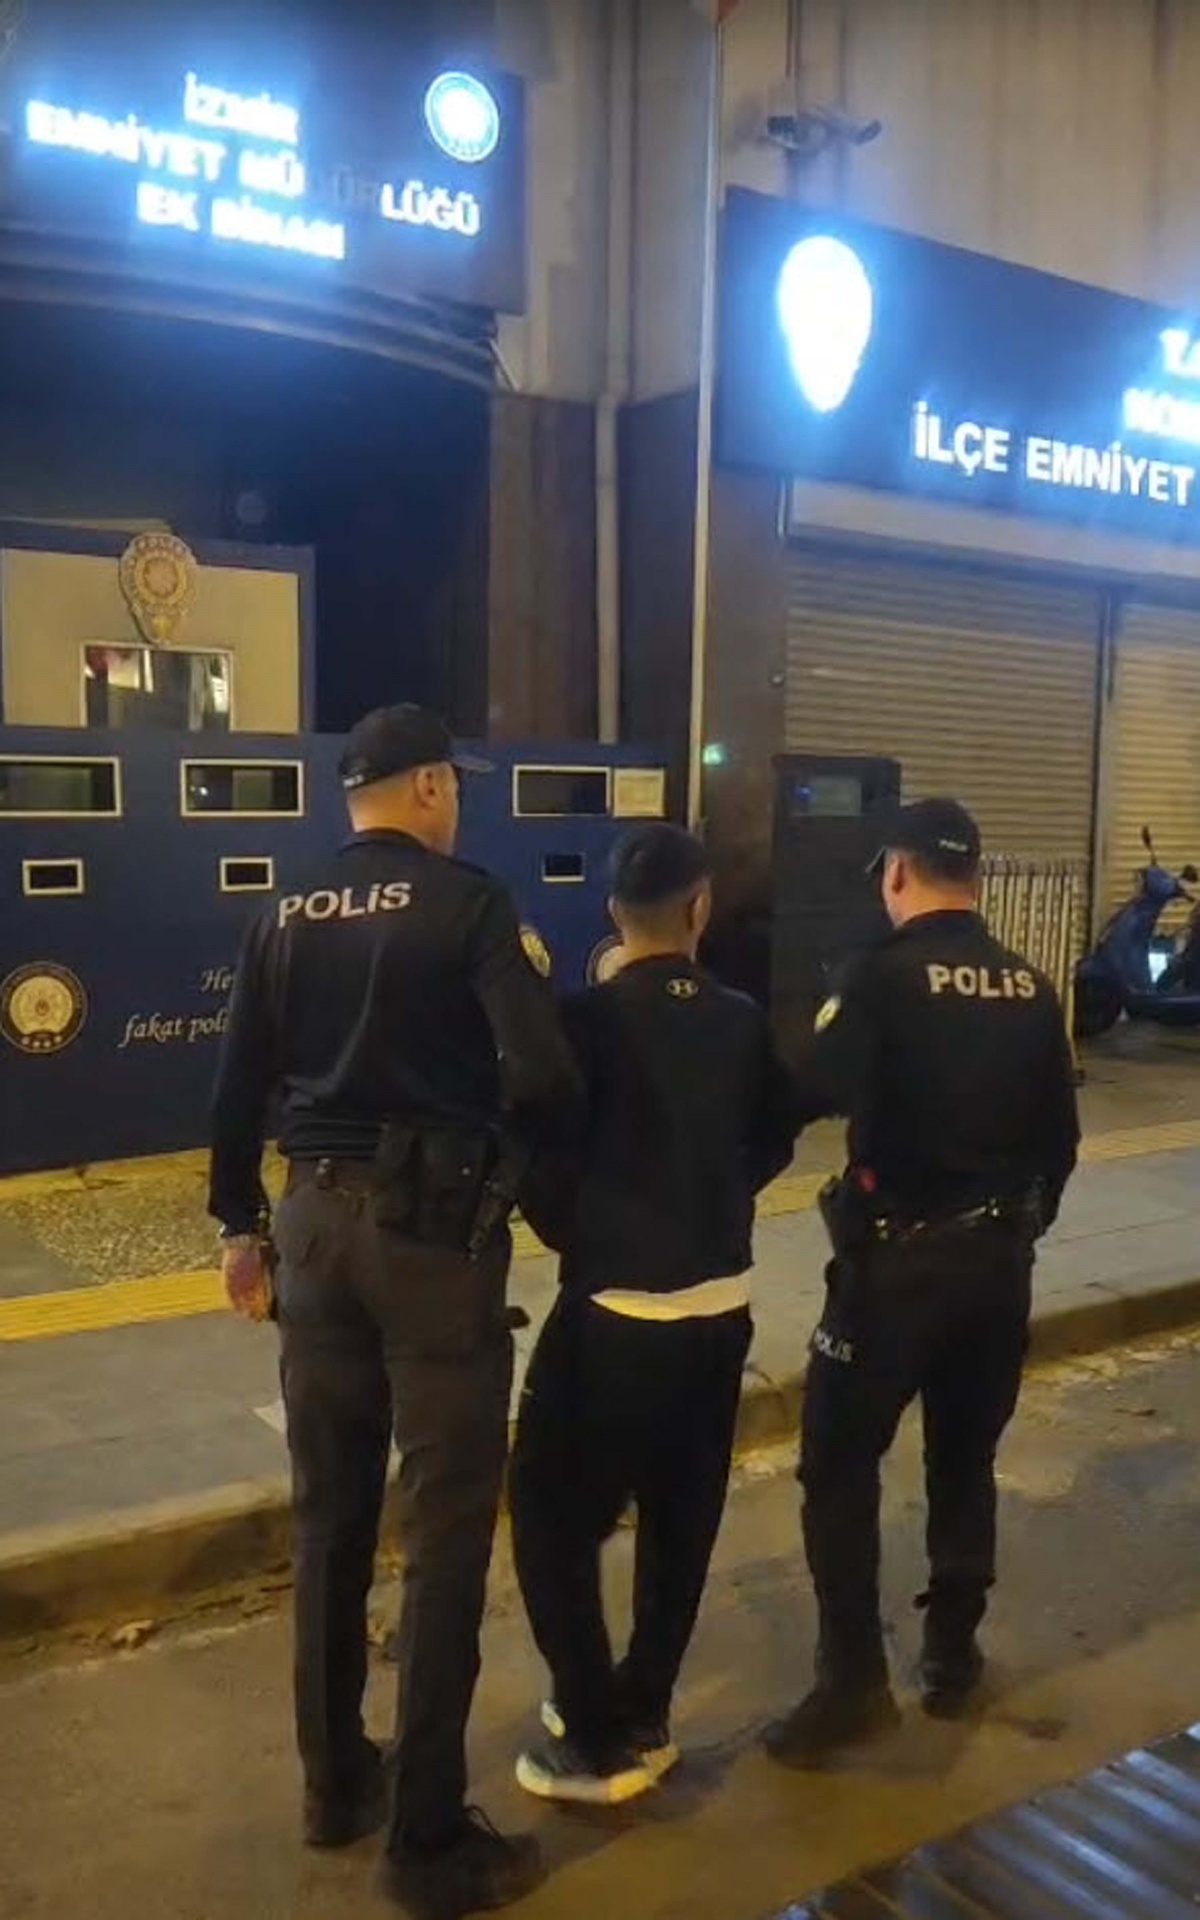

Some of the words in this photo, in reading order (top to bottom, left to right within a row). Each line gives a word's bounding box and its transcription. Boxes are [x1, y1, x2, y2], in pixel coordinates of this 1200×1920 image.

[913, 400, 1011, 476] İLÇE
[1027, 440, 1195, 506] EMNİYET
[200, 966, 233, 993] He
[117, 1012, 182, 1048] fakat
